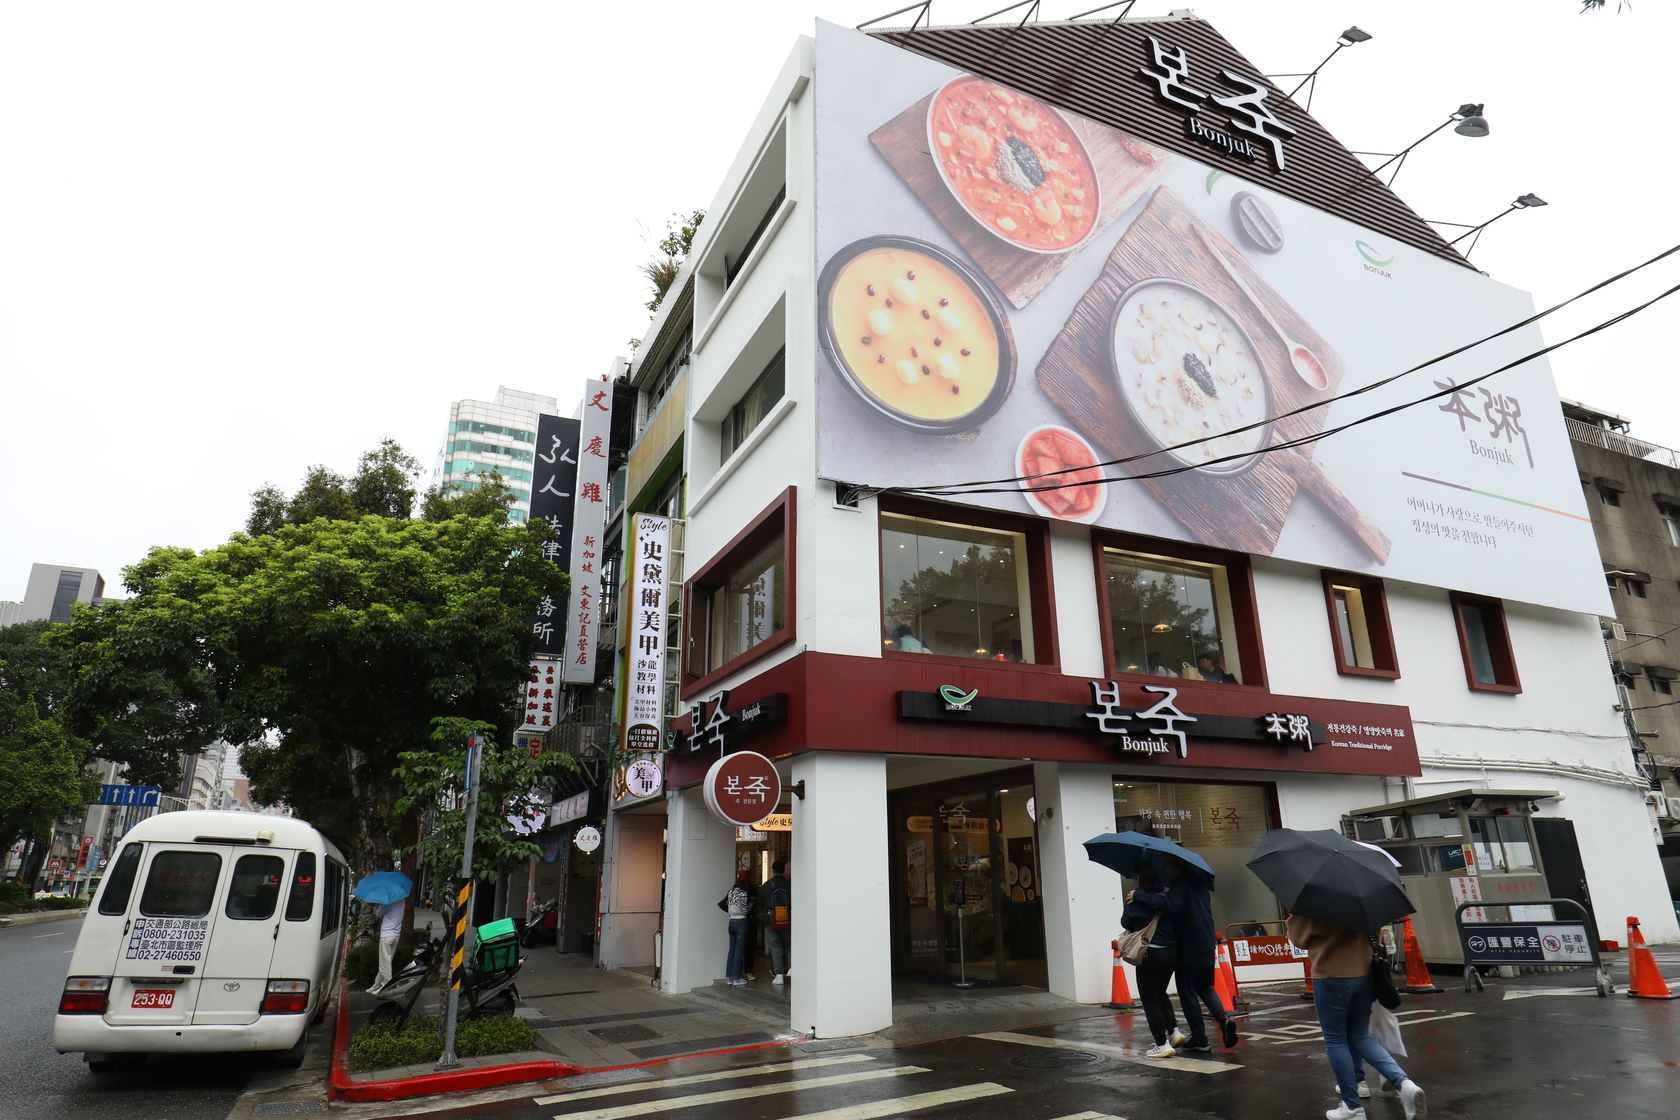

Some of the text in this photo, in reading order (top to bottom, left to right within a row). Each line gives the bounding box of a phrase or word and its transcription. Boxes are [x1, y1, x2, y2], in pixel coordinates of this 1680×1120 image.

[1139, 36, 1298, 170] 본죽
[1189, 117, 1257, 159] Bonjuk
[1363, 262, 1393, 280] BONJUK
[1433, 376, 1535, 469] 本粥
[1469, 438, 1515, 466] Bonjuk
[1406, 496, 1445, 517] 어머니가
[1446, 505, 1482, 524] 사랑으로
[640, 518, 668, 533] Style
[1411, 518, 1497, 549] 정성의 맛을 전합니다
[533, 434, 577, 646] 弘人法律務所
[582, 535, 596, 574] 新加坡
[639, 541, 663, 655] 史黛爾美甲
[637, 659, 658, 670] 沙龍
[636, 671, 657, 682] 教學
[635, 684, 656, 695] 材料
[687, 690, 731, 758] 본죽
[1085, 681, 1198, 759] 본죽
[1265, 713, 1313, 751] 本粥
[1121, 735, 1170, 756] Bonjuk
[1348, 741, 1374, 749] Traditional
[723, 775, 771, 803] 본죽
[1138, 808, 1193, 820] 가장 속 편한 행복
[1209, 806, 1242, 831] 본죽
[145, 919, 208, 930] 交通部公路總局
[143, 929, 206, 940] 0800-231035
[1486, 936, 1540, 948] 匯豐保全
[1561, 934, 1584, 944] 駐車
[140, 940, 203, 950] 臺北市區監理所
[1564, 945, 1588, 954] 停止
[138, 949, 201, 961] 02-27460550
[133, 993, 173, 1006] 253-QQ
